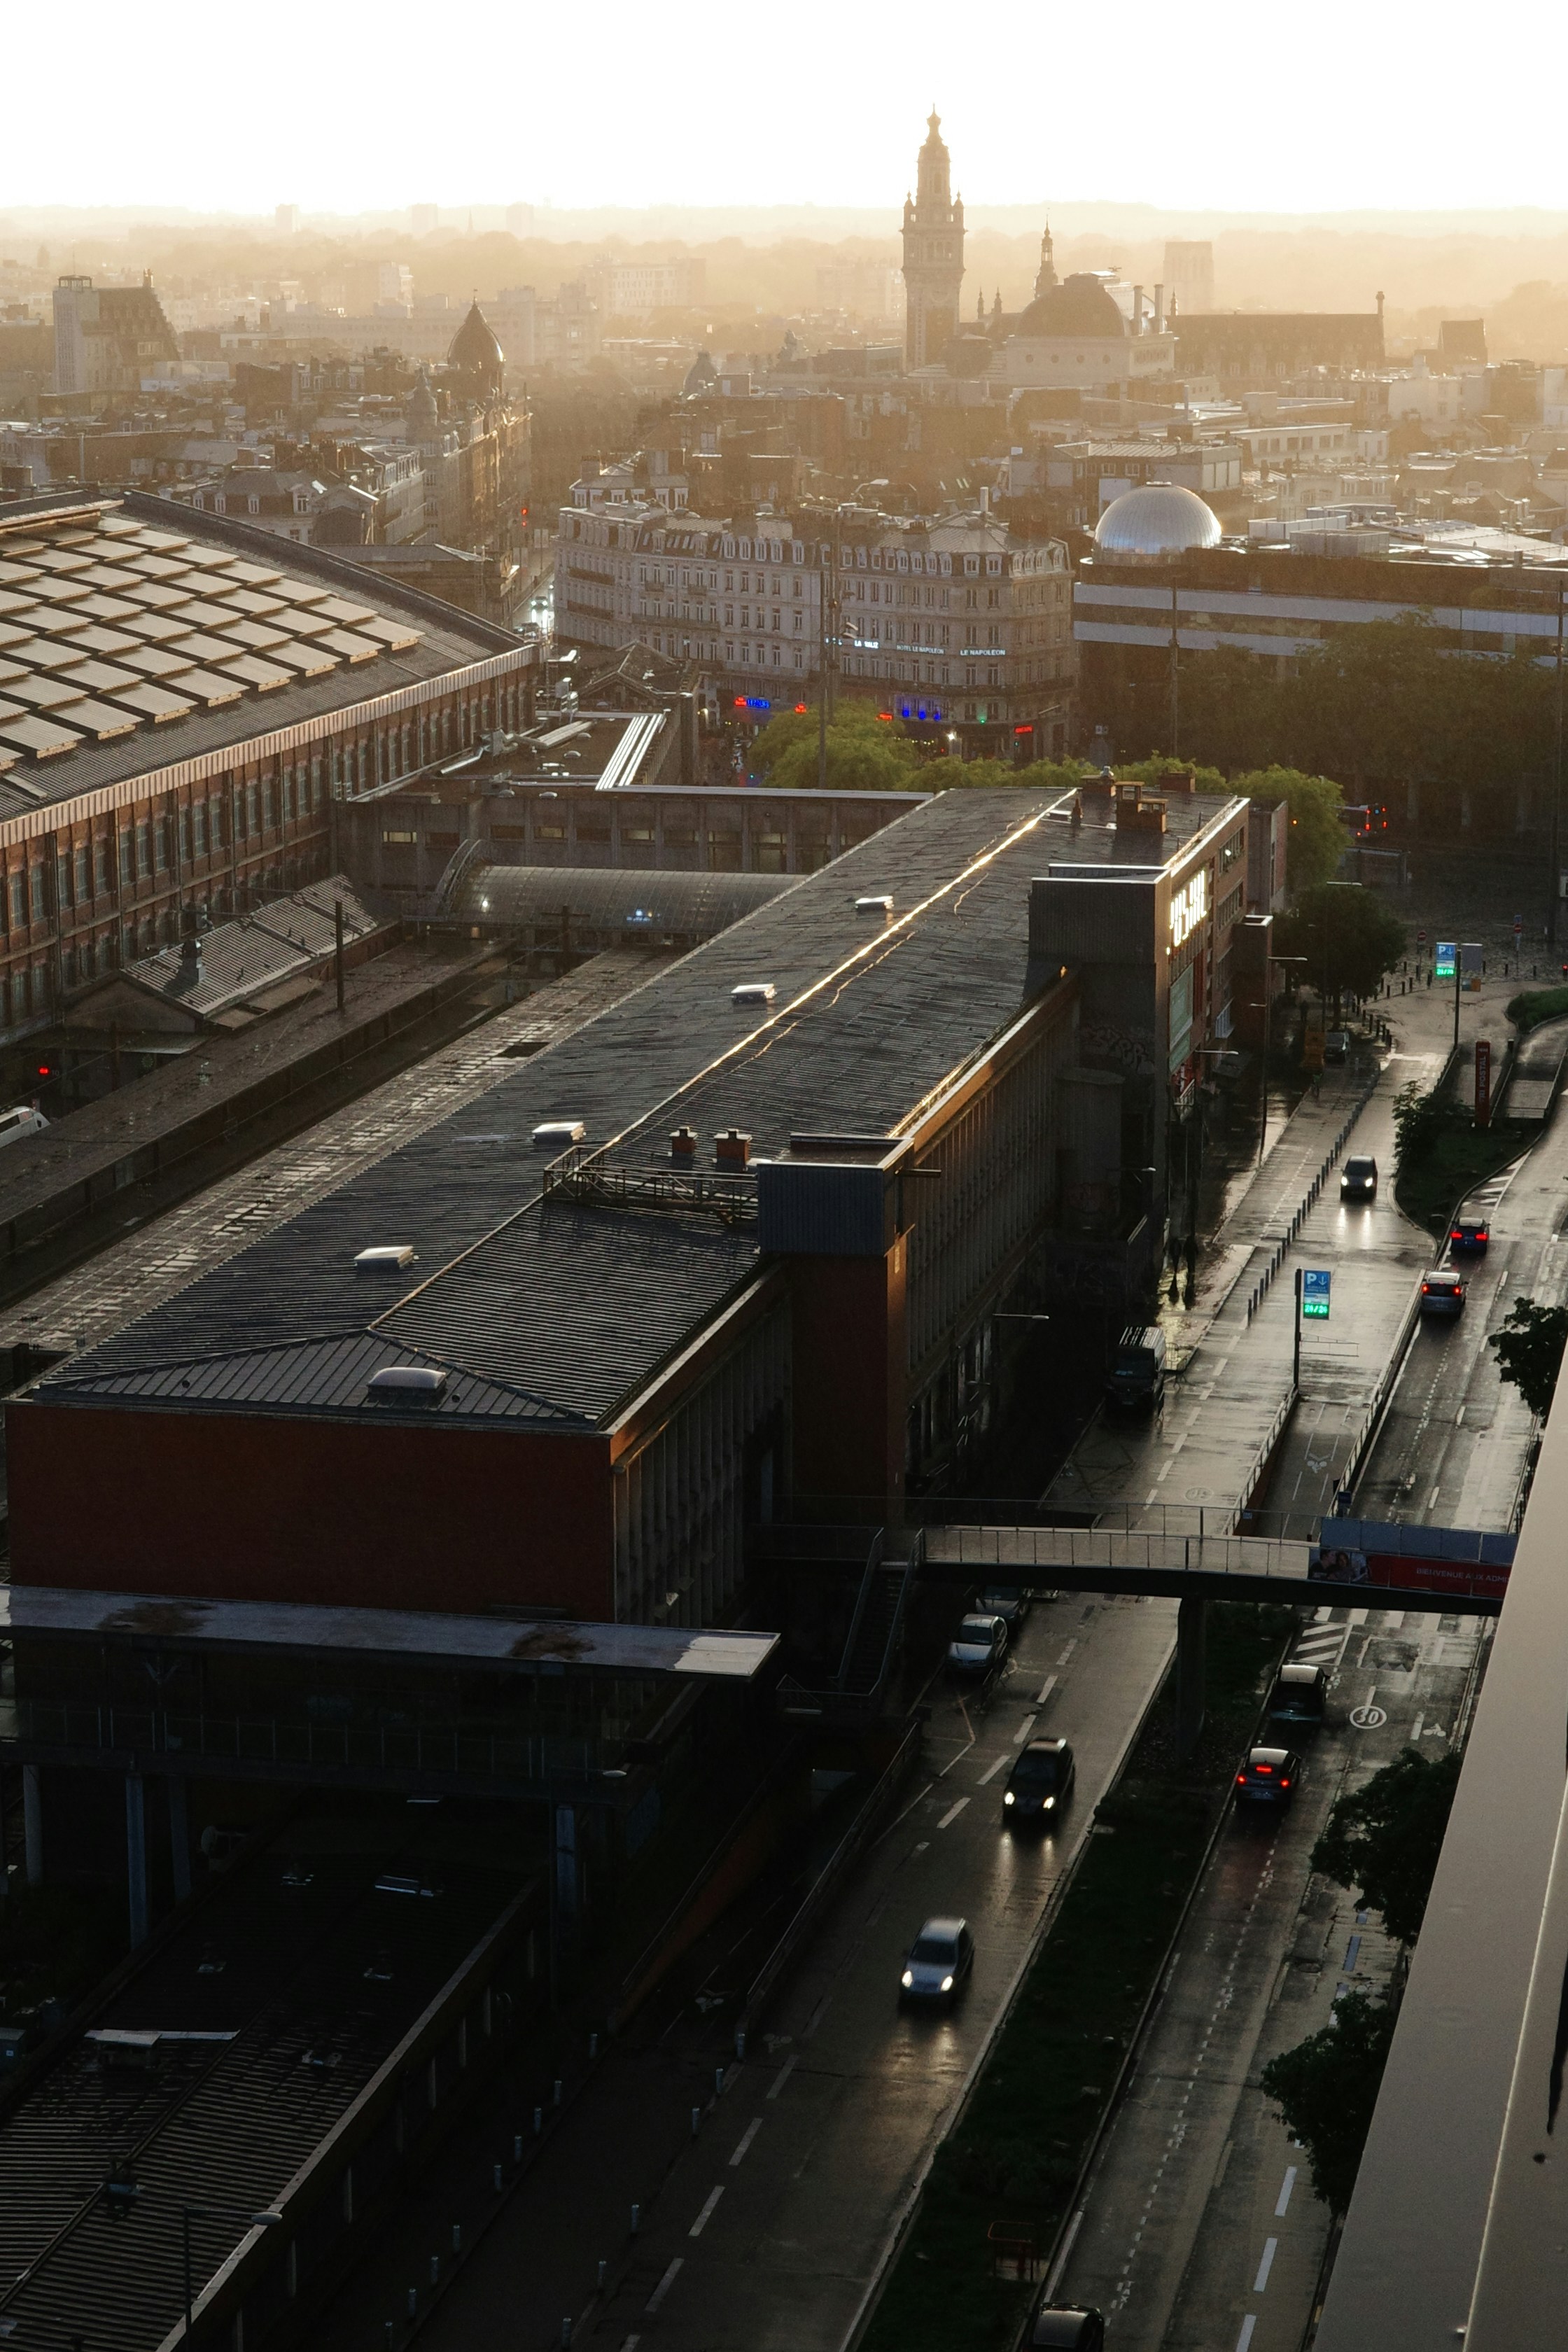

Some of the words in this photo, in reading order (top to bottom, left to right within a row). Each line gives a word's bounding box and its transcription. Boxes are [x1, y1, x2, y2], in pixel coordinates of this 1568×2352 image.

[1438, 945, 1446, 955] P
[1478, 1055, 1487, 1088] POSTAL
[1306, 1273, 1317, 1285] P
[1416, 1567, 1464, 1579] BIENVENUE
[1465, 1573, 1484, 1581] AUX
[1356, 1709, 1380, 1724] 30
